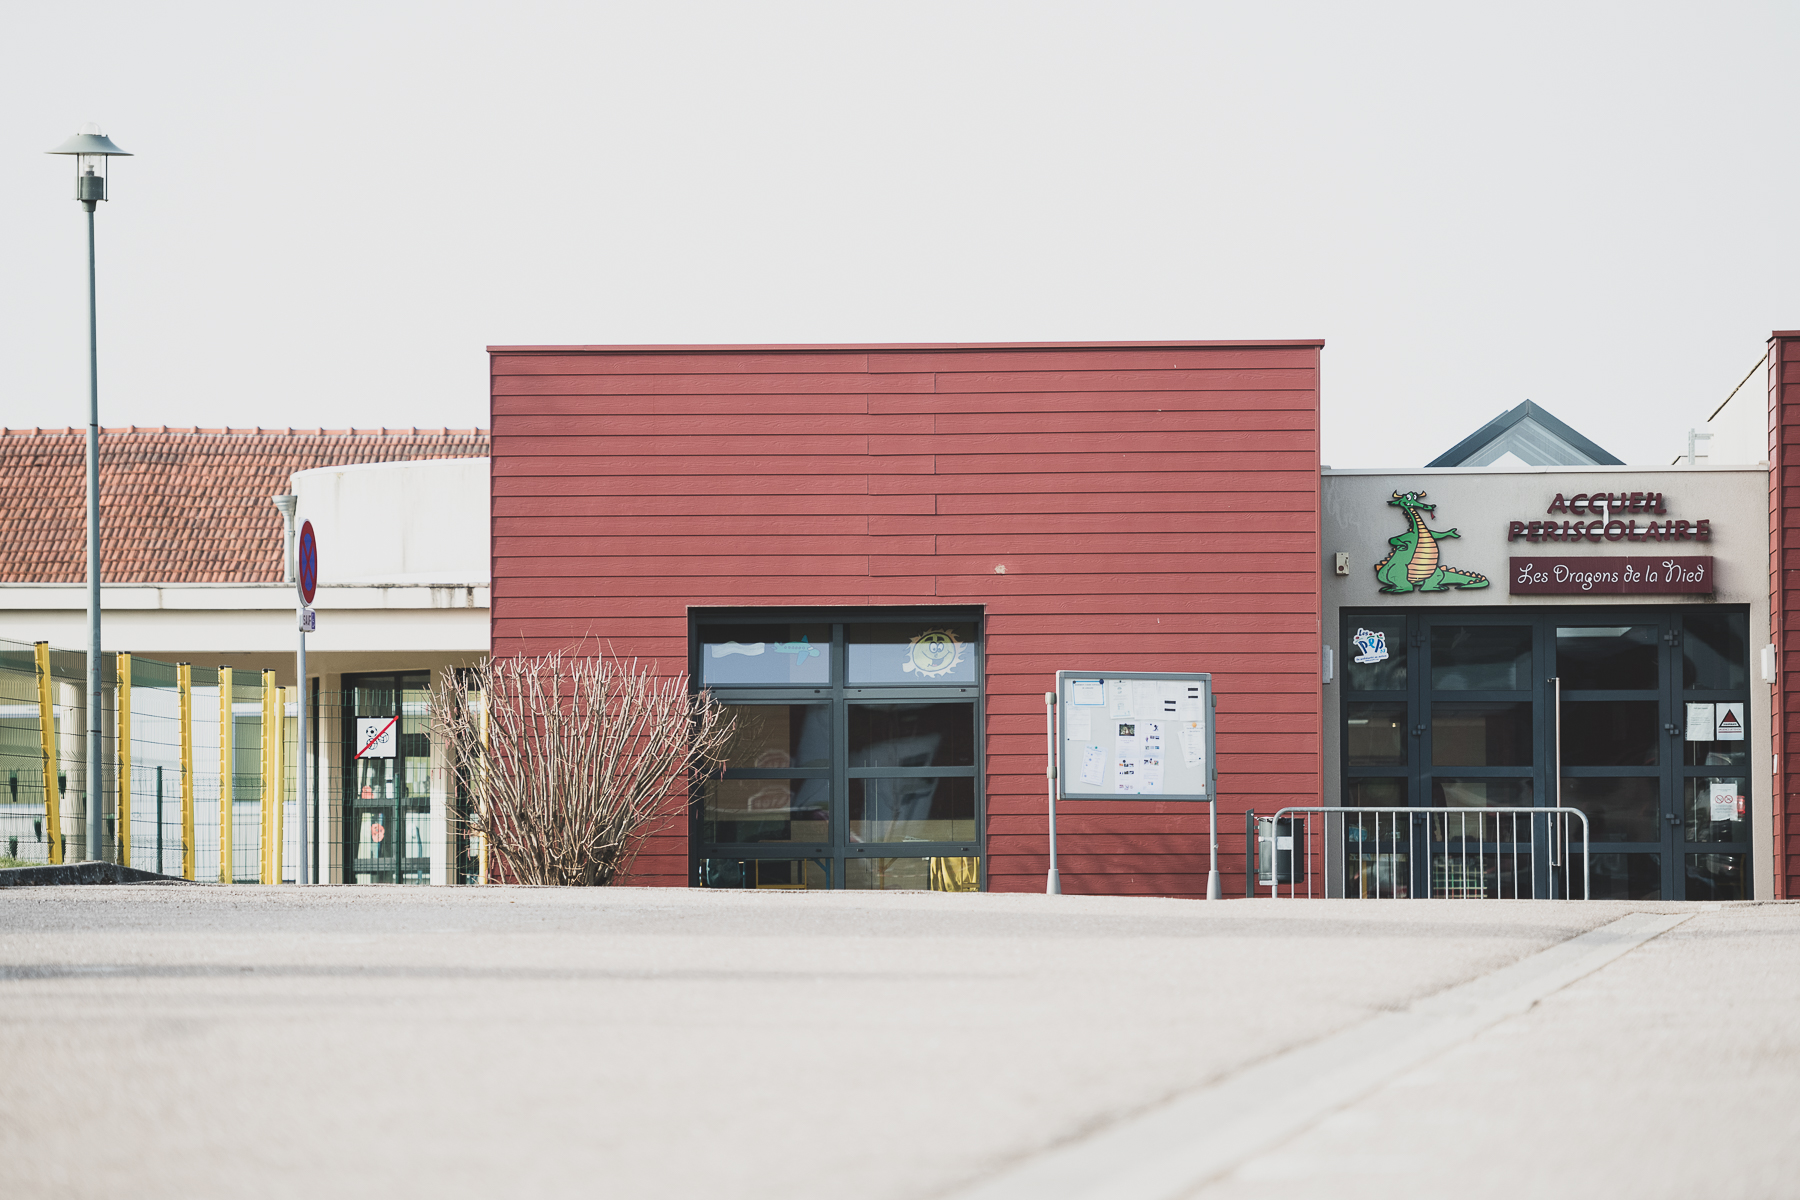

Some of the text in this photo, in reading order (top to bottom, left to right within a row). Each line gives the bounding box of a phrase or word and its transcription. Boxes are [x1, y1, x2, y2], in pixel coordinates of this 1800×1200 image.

[1547, 492, 1667, 514] ACCUEIL
[1508, 519, 1710, 542] PERISCOLAIRE
[1517, 559, 1705, 591] Les Dragons de la Nied
